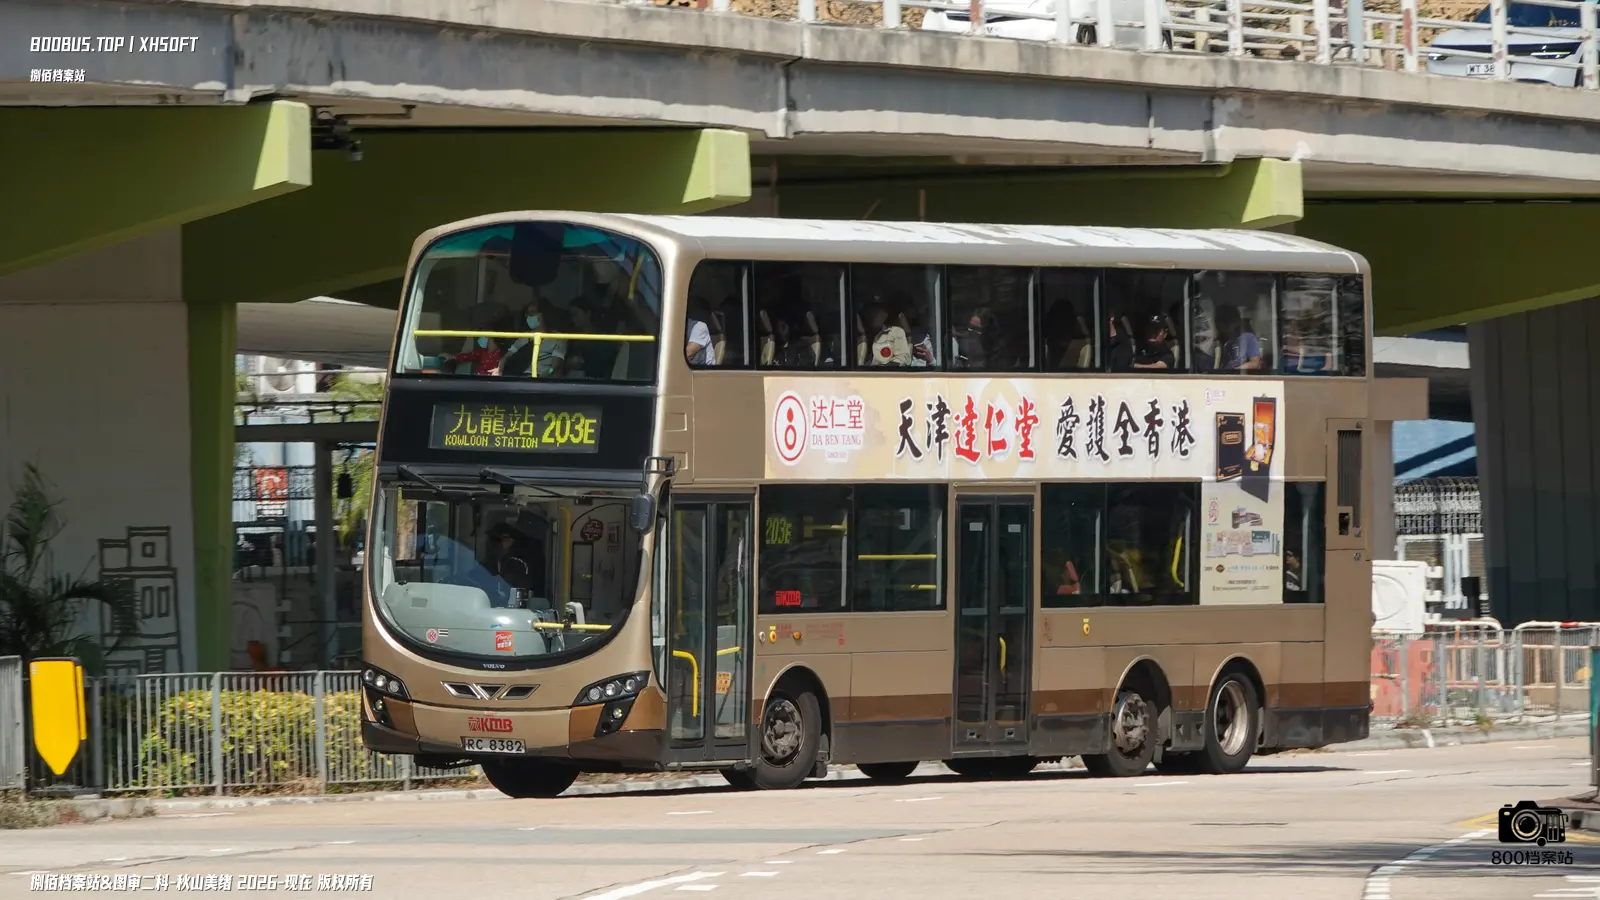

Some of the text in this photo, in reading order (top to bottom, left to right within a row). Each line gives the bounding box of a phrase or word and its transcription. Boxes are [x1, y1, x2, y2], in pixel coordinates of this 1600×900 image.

[1469, 64, 1481, 73] WT
[450, 404, 536, 436] 九龍站
[812, 399, 863, 429] 达仁堂
[541, 412, 597, 445] 203E
[896, 394, 1195, 462] 天津達仁堂 愛護全香港
[445, 435, 538, 448] KOWLOON STATION
[812, 434, 862, 446] DA REN TANG
[765, 516, 792, 544] 203E
[480, 717, 513, 732] KMB
[467, 739, 523, 752] RC 8382
